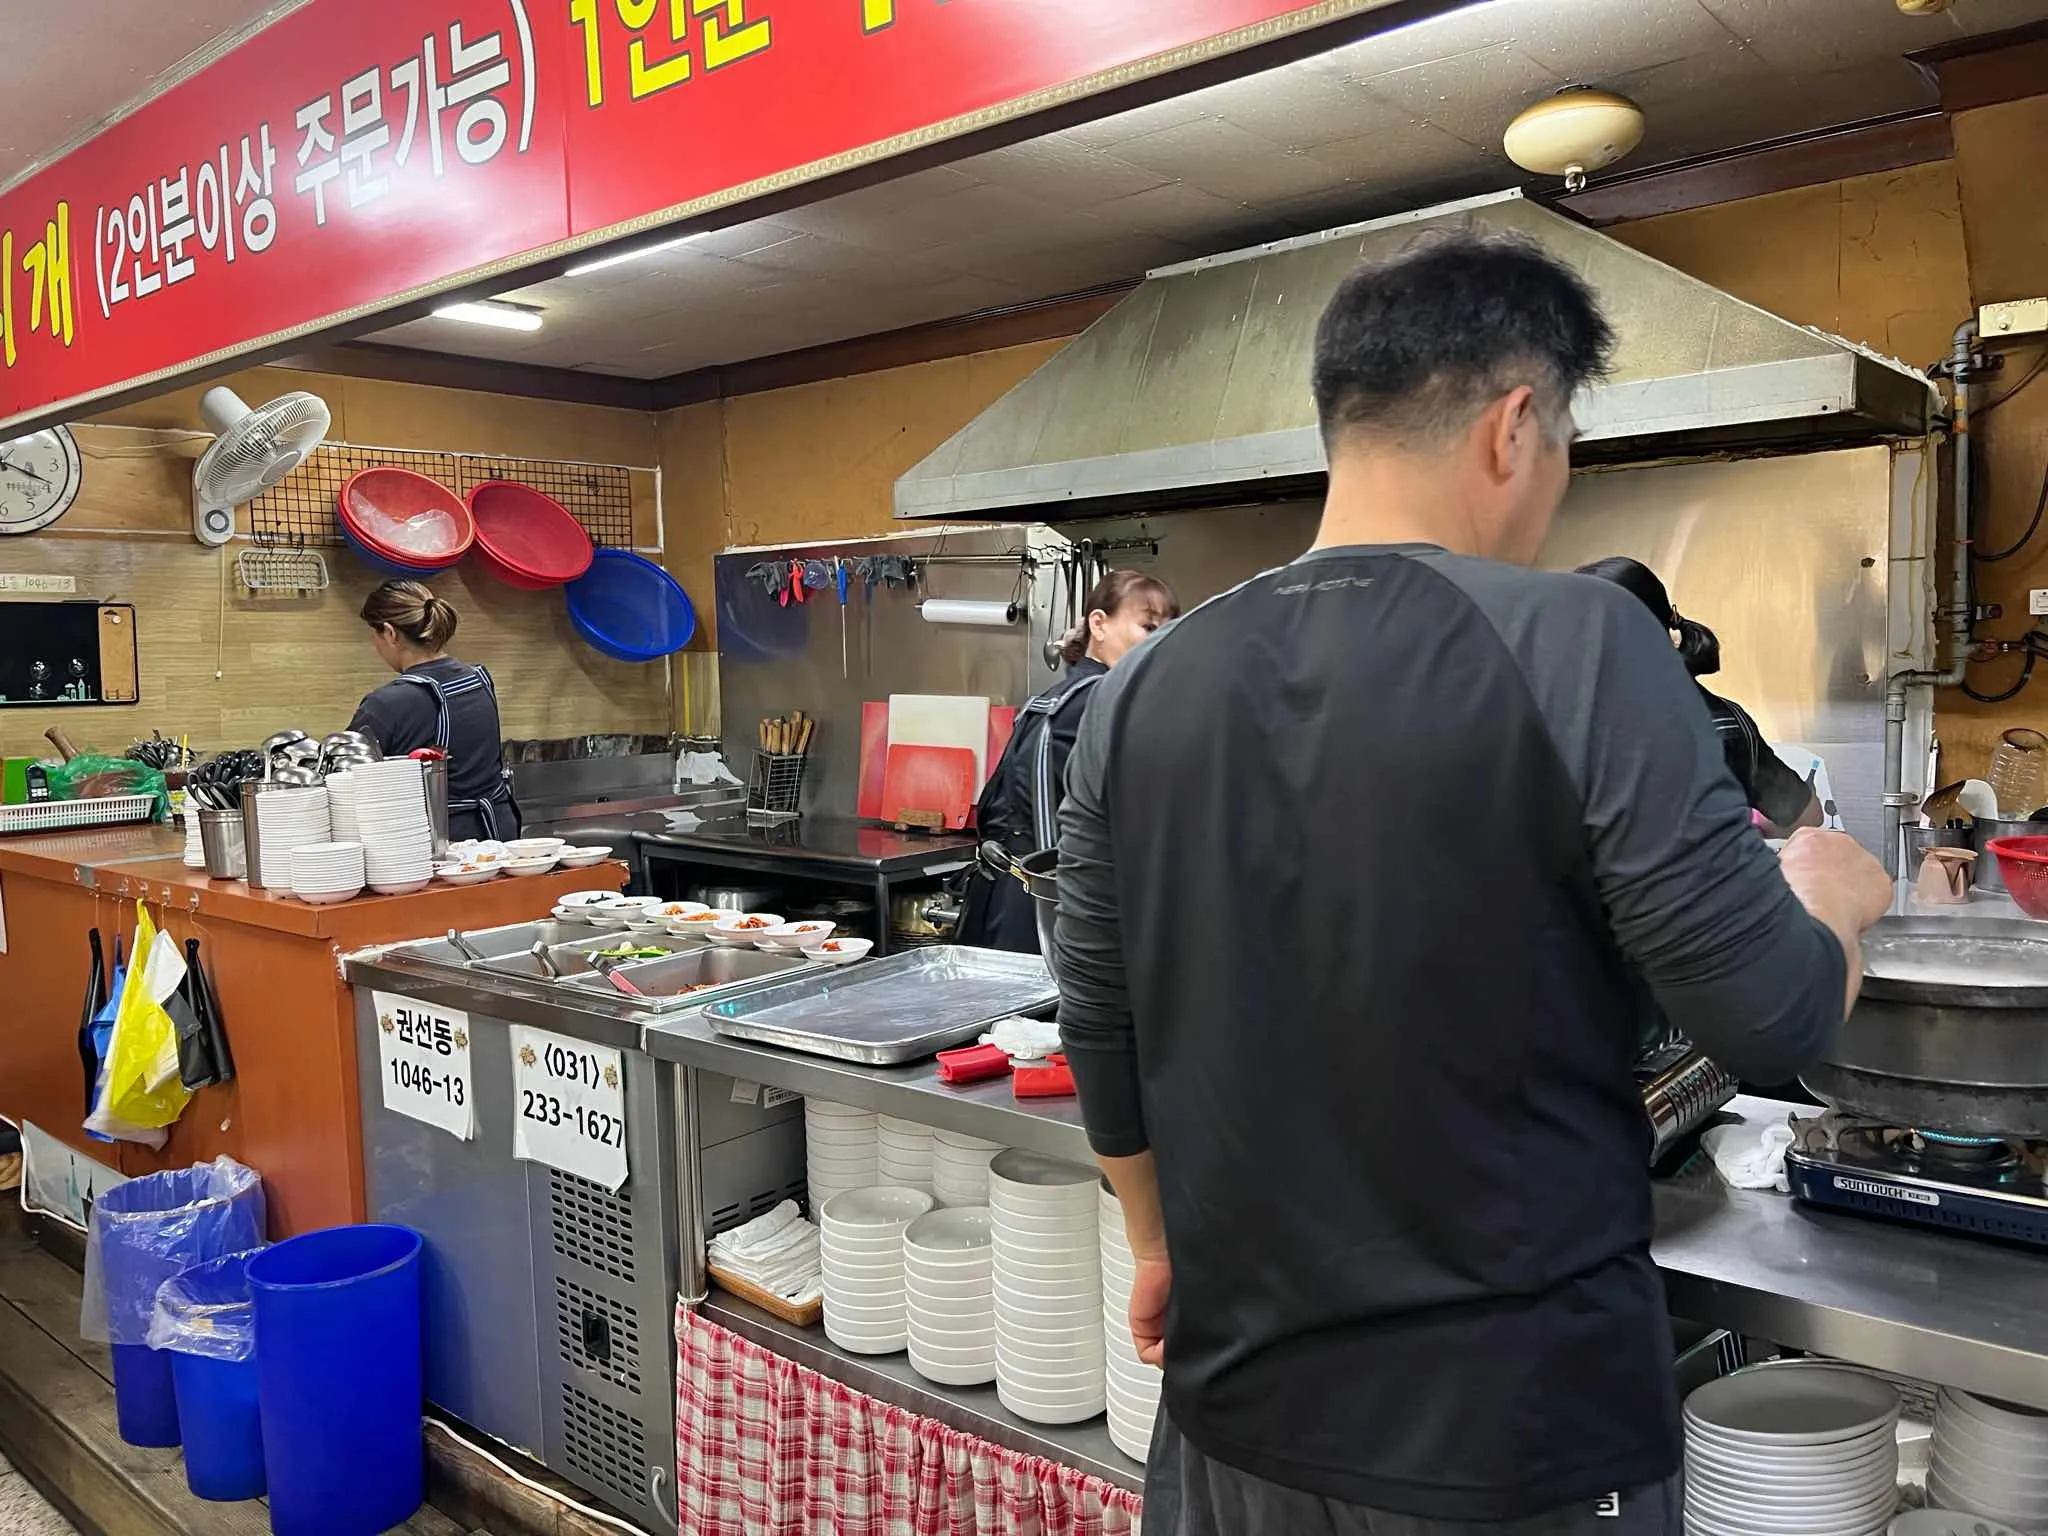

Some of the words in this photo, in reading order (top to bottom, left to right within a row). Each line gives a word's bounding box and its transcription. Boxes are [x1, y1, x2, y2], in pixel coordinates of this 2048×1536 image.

[95, 121, 277, 320] (2인분이상
[295, 0, 537, 226] 주문가능)
[396, 1008, 453, 1056] 권선동
[391, 1058, 464, 1106] 1046-13
[523, 1090, 623, 1149] 233-1627
[1840, 1179, 1903, 1198] SUNTOUCH
